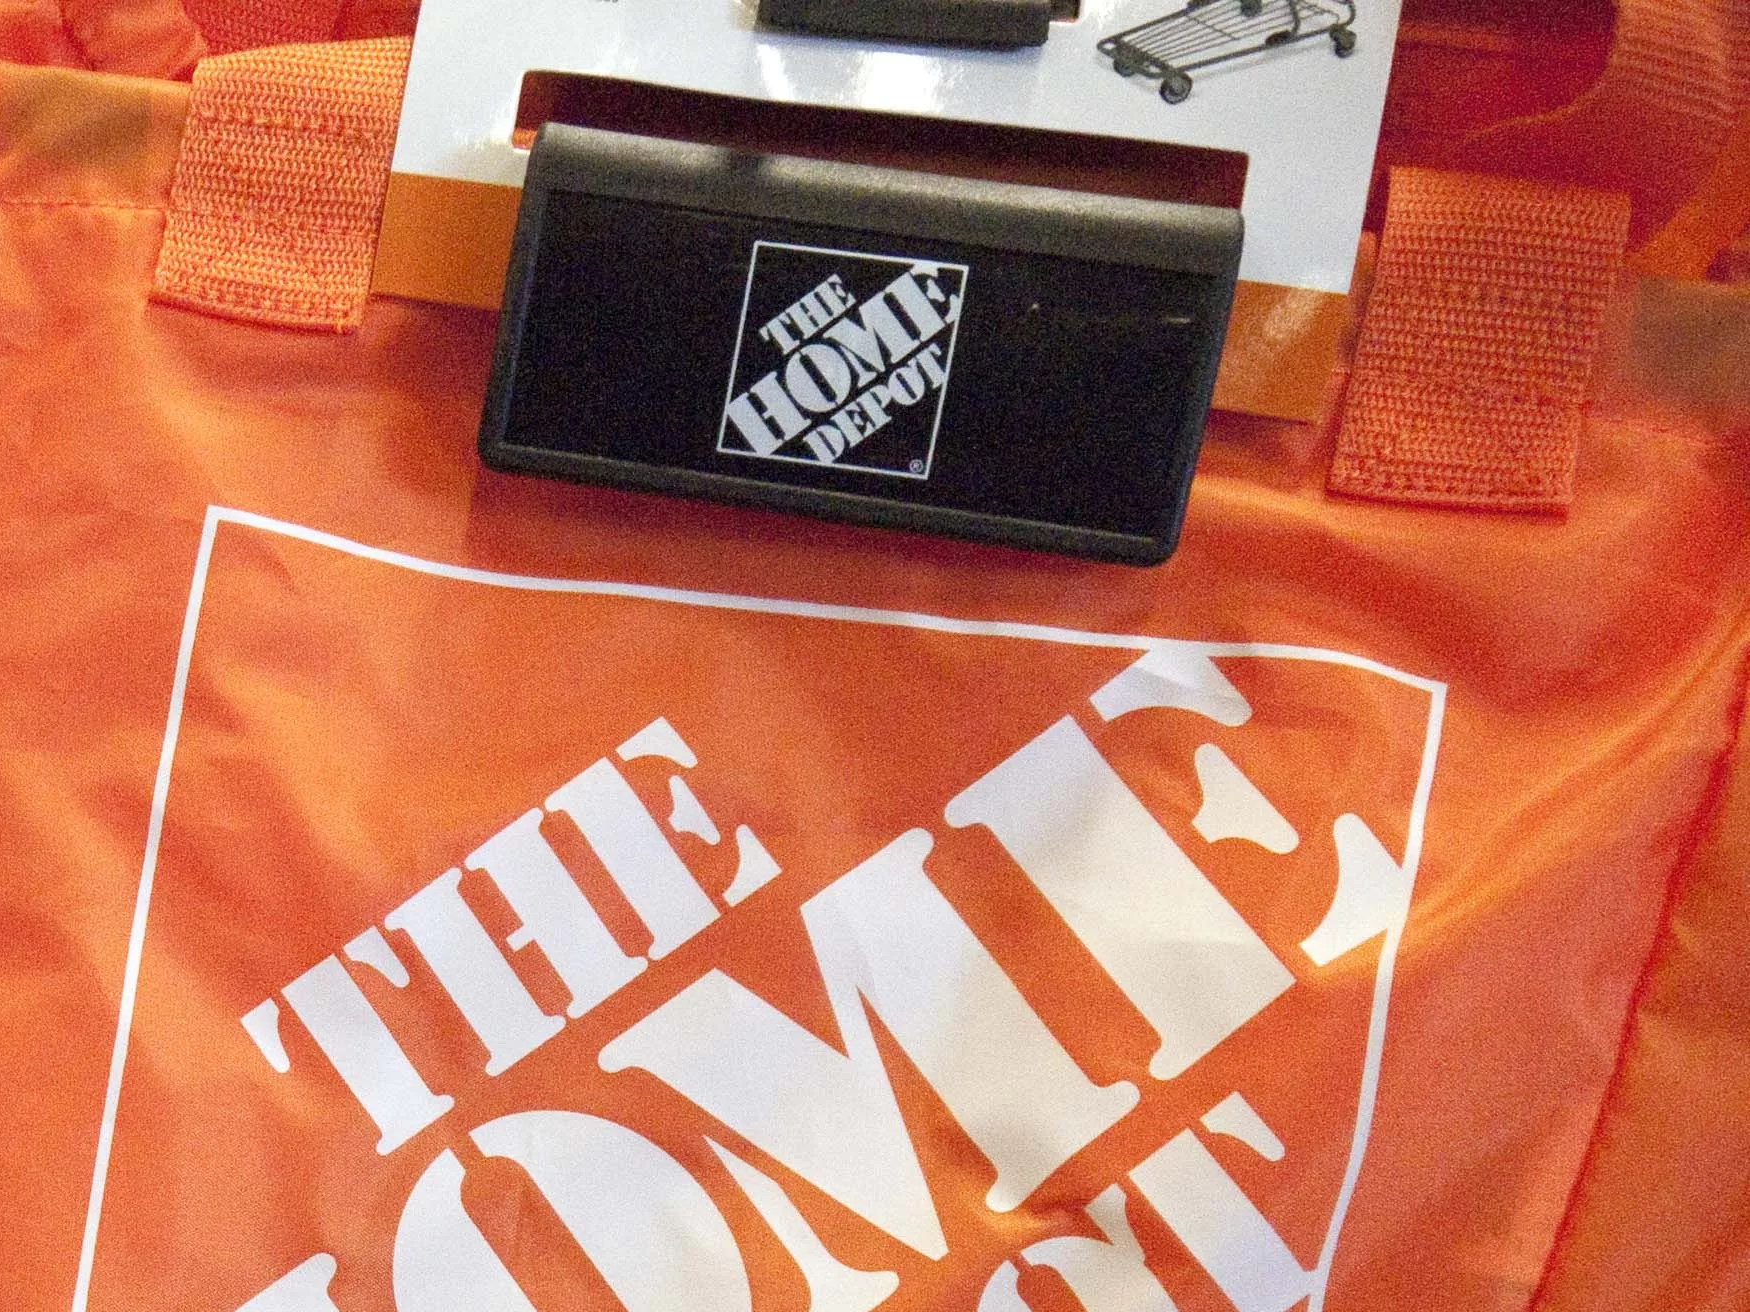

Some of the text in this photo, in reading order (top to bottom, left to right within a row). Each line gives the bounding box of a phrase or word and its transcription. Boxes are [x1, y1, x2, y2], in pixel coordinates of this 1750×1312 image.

[727, 261, 961, 457] HOME
[758, 273, 857, 357] THE
[802, 343, 948, 464] DEPOT
[239, 716, 782, 1156] THE
